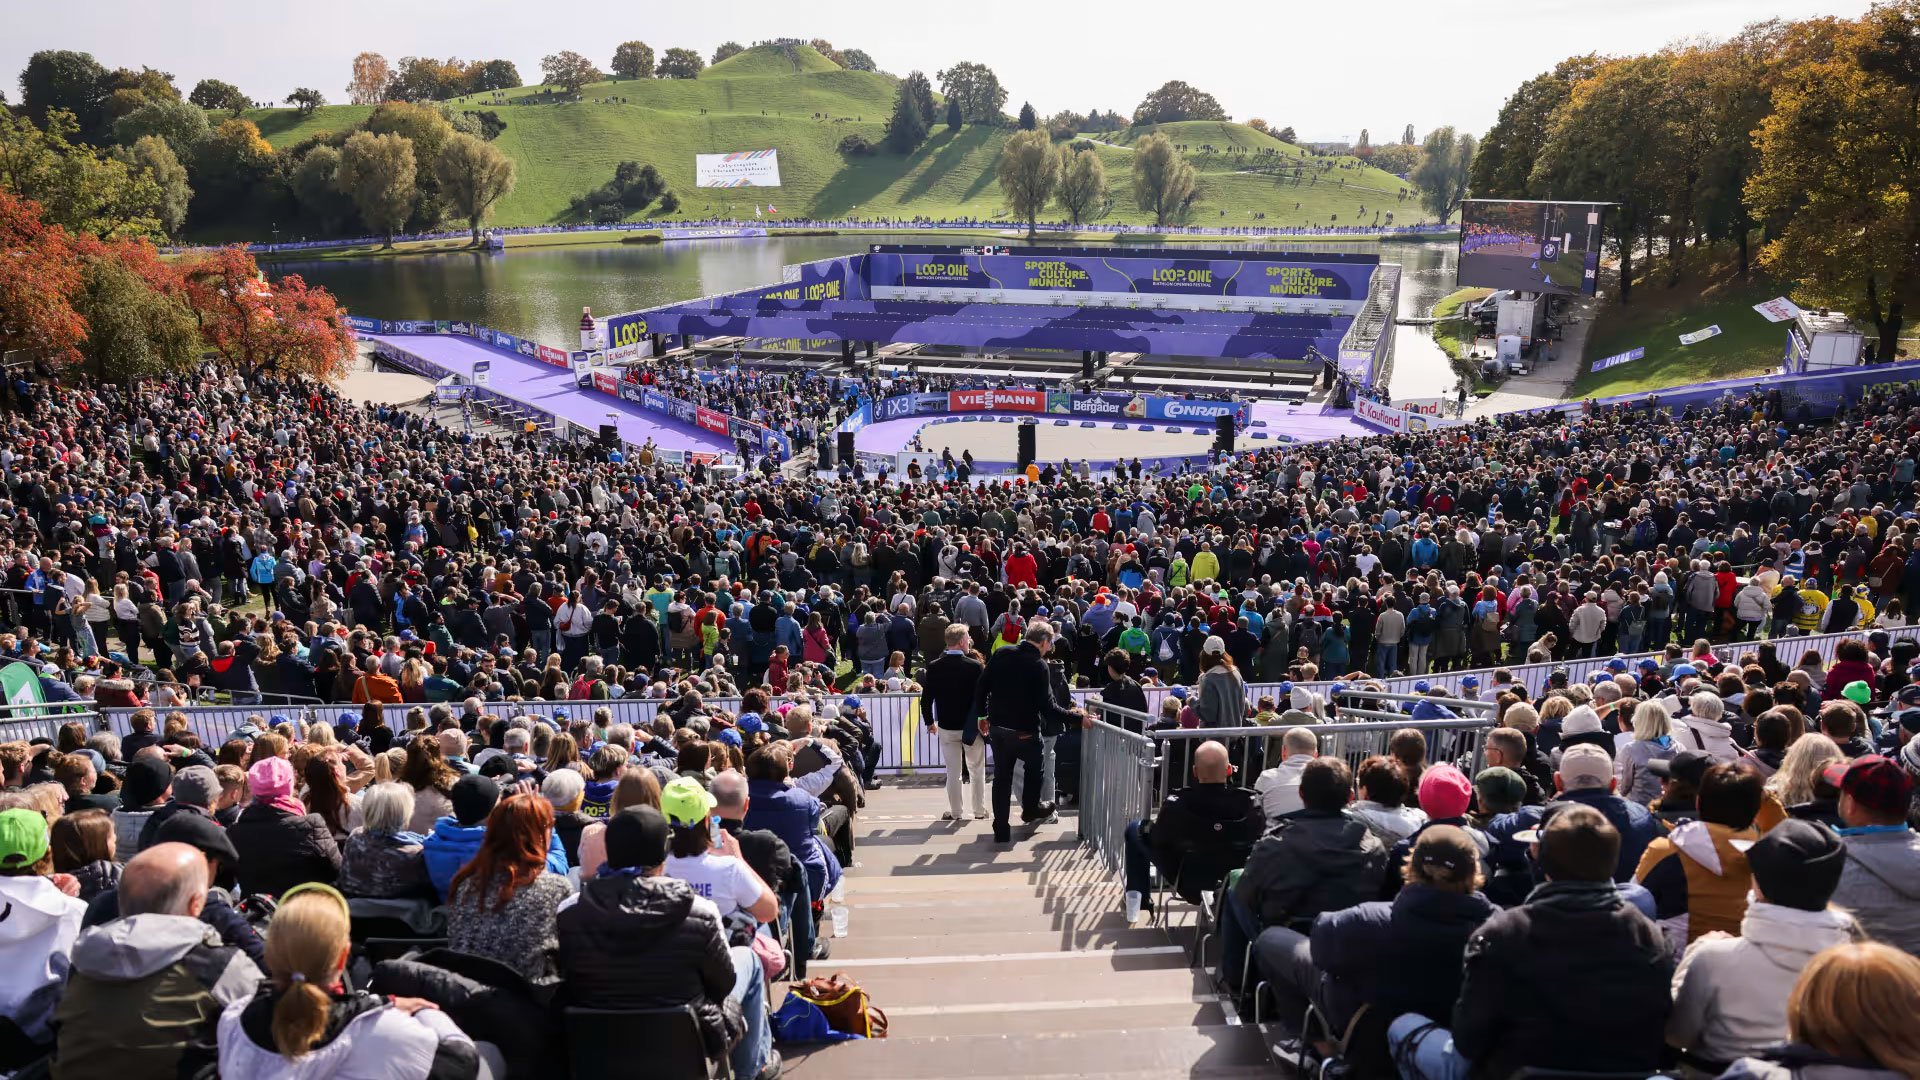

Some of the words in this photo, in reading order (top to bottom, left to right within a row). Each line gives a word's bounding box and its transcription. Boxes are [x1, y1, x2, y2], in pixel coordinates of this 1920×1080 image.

[915, 263, 945, 276] LOOP
[947, 264, 969, 277] ONE
[1024, 261, 1069, 270] SPORTS.
[1265, 266, 1315, 277] SPORTS.
[1039, 269, 1089, 279] CULTURE.
[1152, 268, 1186, 281] LOOP
[1187, 269, 1212, 283] ONE
[1028, 278, 1076, 287] MUNICH.
[1281, 276, 1337, 287] CULTURE.
[1269, 284, 1322, 295] MUNICH.
[395, 321, 412, 333] iX3
[887, 398, 909, 415] iX3
[958, 391, 1036, 410] VIESSMANN
[1073, 397, 1120, 414] Bergader
[1163, 401, 1230, 418] CONRAD
[1367, 403, 1400, 428] Kaufland
